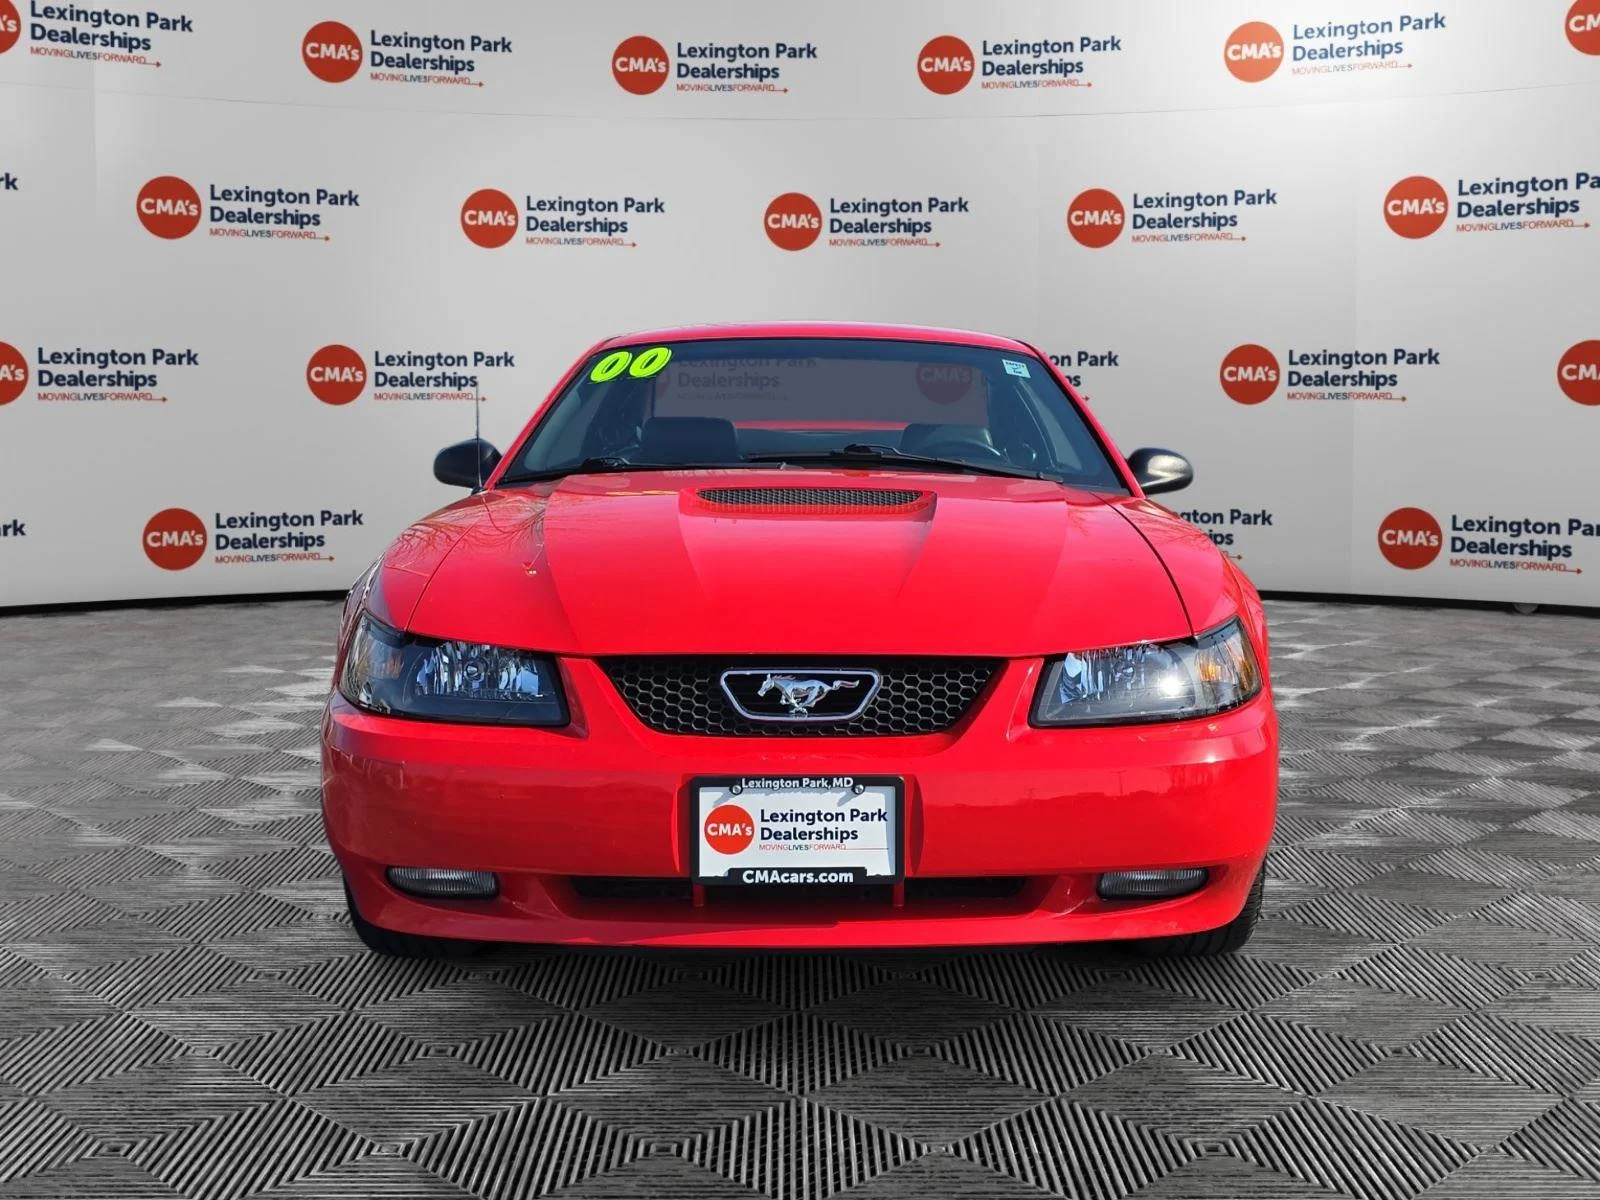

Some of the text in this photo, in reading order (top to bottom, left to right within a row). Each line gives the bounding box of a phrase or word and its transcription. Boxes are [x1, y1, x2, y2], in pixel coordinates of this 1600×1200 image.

[31, 0, 139, 28] Lexington
[146, 12, 193, 32] Park
[1293, 12, 1445, 43] Lexington Park
[31, 23, 151, 53] Dealerships
[371, 30, 512, 53] Lexington Park
[983, 36, 1121, 58] Lexington Park
[306, 43, 359, 60] CMA's
[677, 42, 817, 63] Lexington Park
[1227, 42, 1281, 61] CMA's
[1293, 39, 1403, 62] Dealerships
[371, 51, 474, 75] Dealerships
[615, 57, 666, 72] CMA's
[677, 63, 779, 82] Dealerships
[921, 57, 971, 72] CMA's
[982, 59, 1083, 77] Dealerships
[210, 184, 359, 207] Lexington Park
[1458, 177, 1568, 200] Lexington
[141, 198, 198, 216] CMA's
[526, 196, 665, 217] Lexington Park
[830, 197, 968, 217] Lexington Park
[1134, 189, 1277, 211] Lexington Park
[1387, 198, 1445, 216] CMA's
[1457, 197, 1580, 218] Dealerships
[210, 206, 320, 229] Dealerships
[464, 210, 515, 226] CMA's
[526, 216, 628, 236] Dealerships
[768, 214, 819, 228] CMA's
[1071, 210, 1122, 225] CMA's
[1133, 212, 1237, 231] Dealerships
[830, 218, 932, 237] Dealerships
[38, 347, 199, 369] Lexington Park
[375, 351, 514, 371] Lexington Park
[1078, 351, 1119, 366] Park
[1289, 348, 1440, 370] Lexington Park
[38, 370, 157, 391] Dealerships
[311, 367, 363, 382] CMA's
[375, 371, 478, 391] Dealerships
[1224, 366, 1276, 381] CMA's
[1288, 370, 1397, 390] Dealerships
[216, 510, 363, 532] Lexington Park
[1230, 509, 1272, 526] Park
[1452, 515, 1561, 538] Lexington
[147, 530, 203, 547] CMA's
[216, 532, 325, 551] Dealerships
[1382, 530, 1438, 546] CMA's
[1451, 536, 1572, 561] Dealerships
[742, 778, 799, 791] Lexington
[760, 809, 888, 825] Lexington Park
[707, 823, 753, 836] CMA's
[760, 827, 858, 843] Dealerships
[742, 869, 854, 884] CMAcars.com
